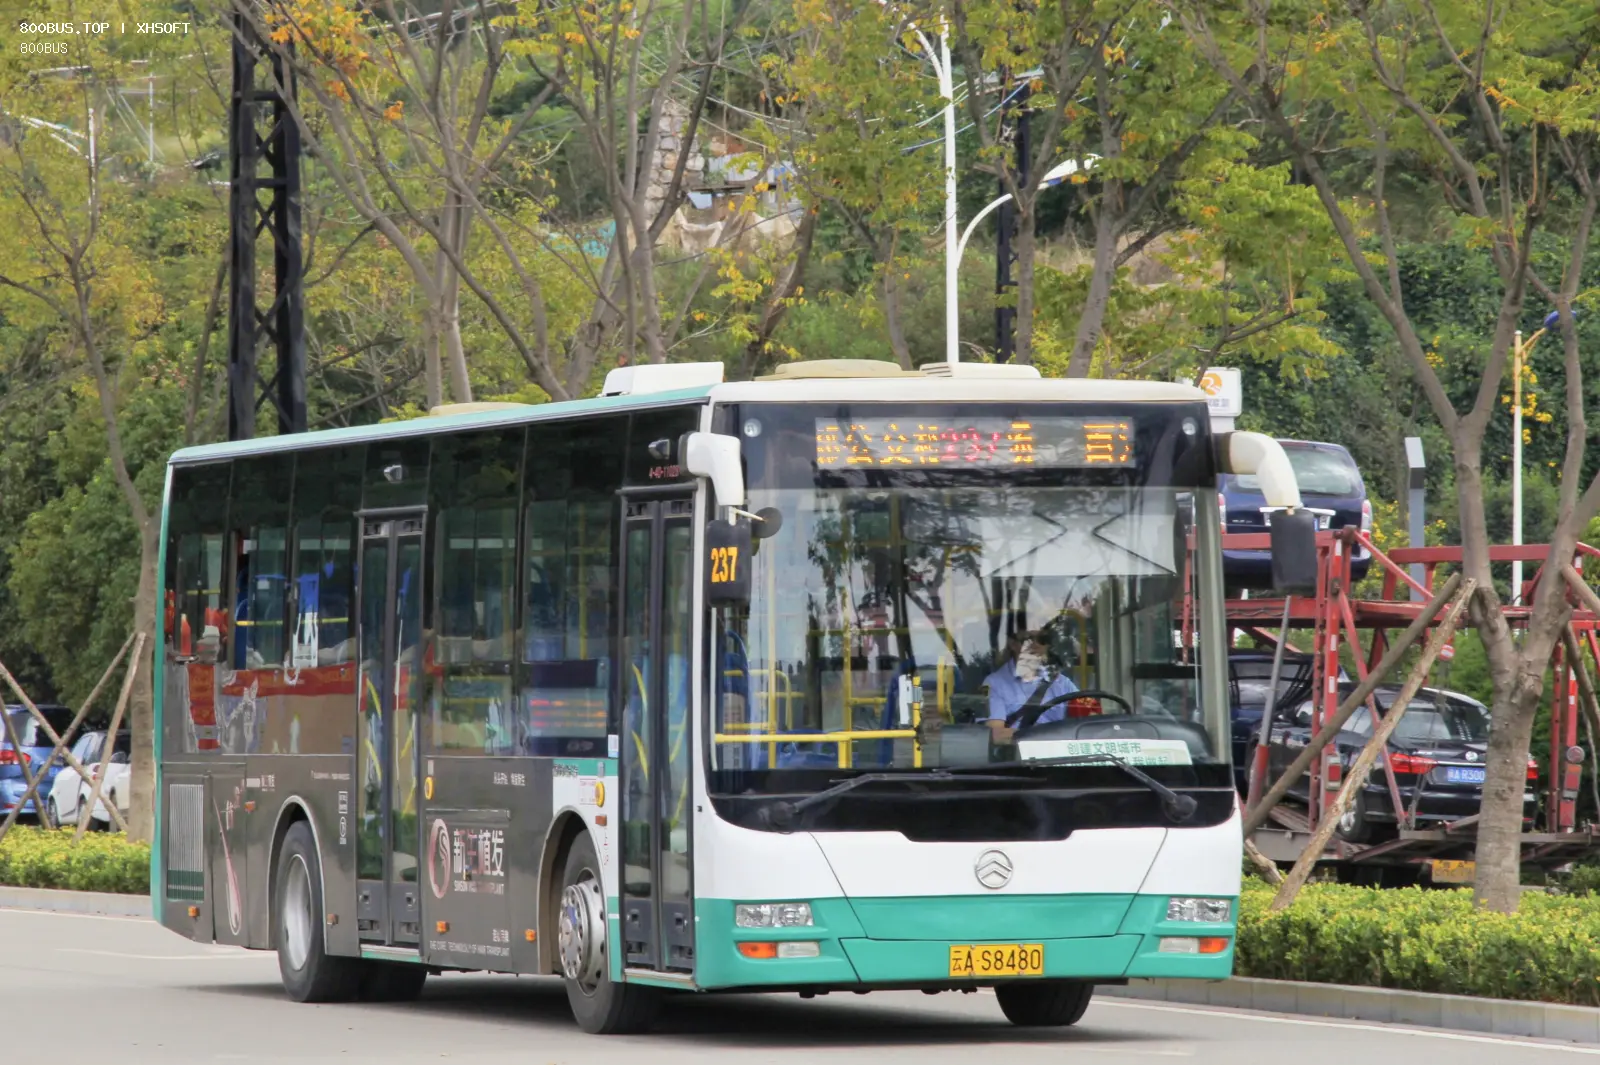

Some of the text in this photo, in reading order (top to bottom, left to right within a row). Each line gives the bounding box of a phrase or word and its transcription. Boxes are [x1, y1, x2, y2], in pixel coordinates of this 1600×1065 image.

[710, 546, 739, 583] 237
[1066, 741, 1142, 755] 创建文明城市
[453, 829, 505, 877] 新生植发
